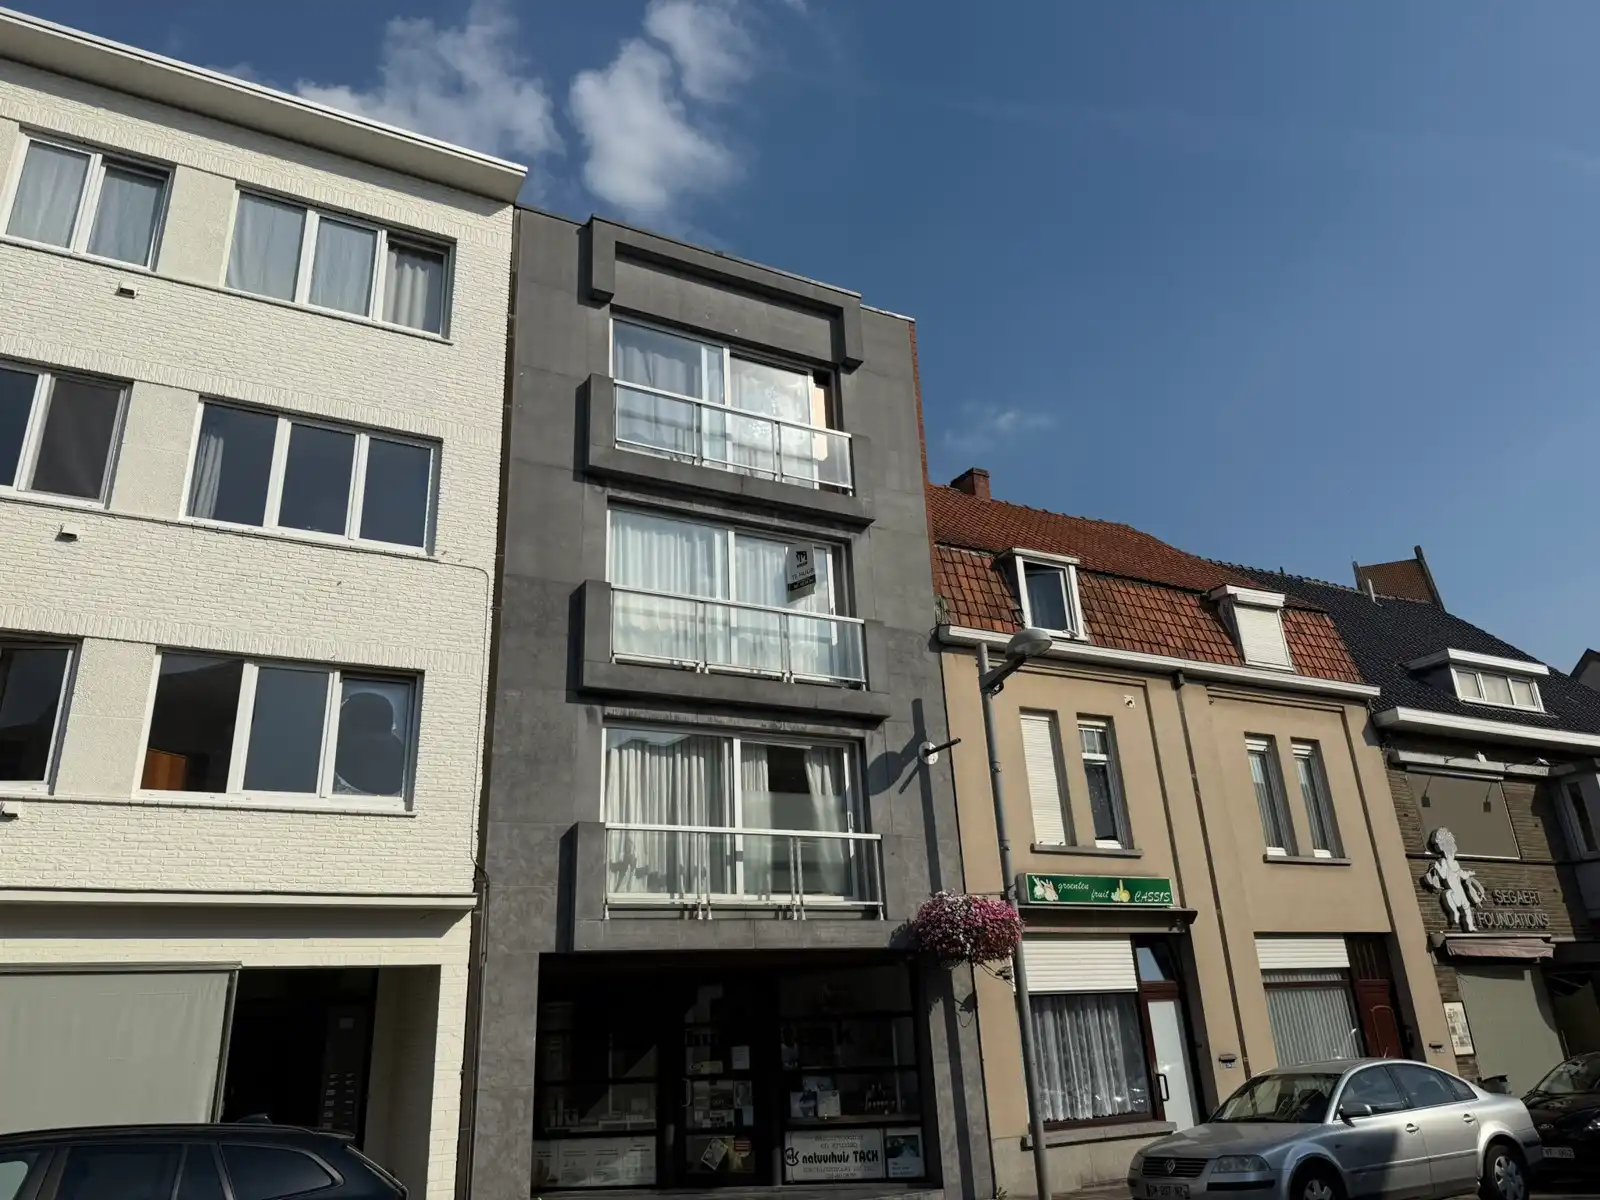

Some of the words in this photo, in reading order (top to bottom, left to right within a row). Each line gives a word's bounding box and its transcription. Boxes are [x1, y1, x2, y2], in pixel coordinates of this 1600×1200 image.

[1057, 881, 1089, 893] groenten
[1091, 888, 1110, 899] fruit
[1134, 890, 1171, 903] CASSIS
[1494, 890, 1542, 904] SEGAERT
[1477, 912, 1550, 927] FOUNDATIONS
